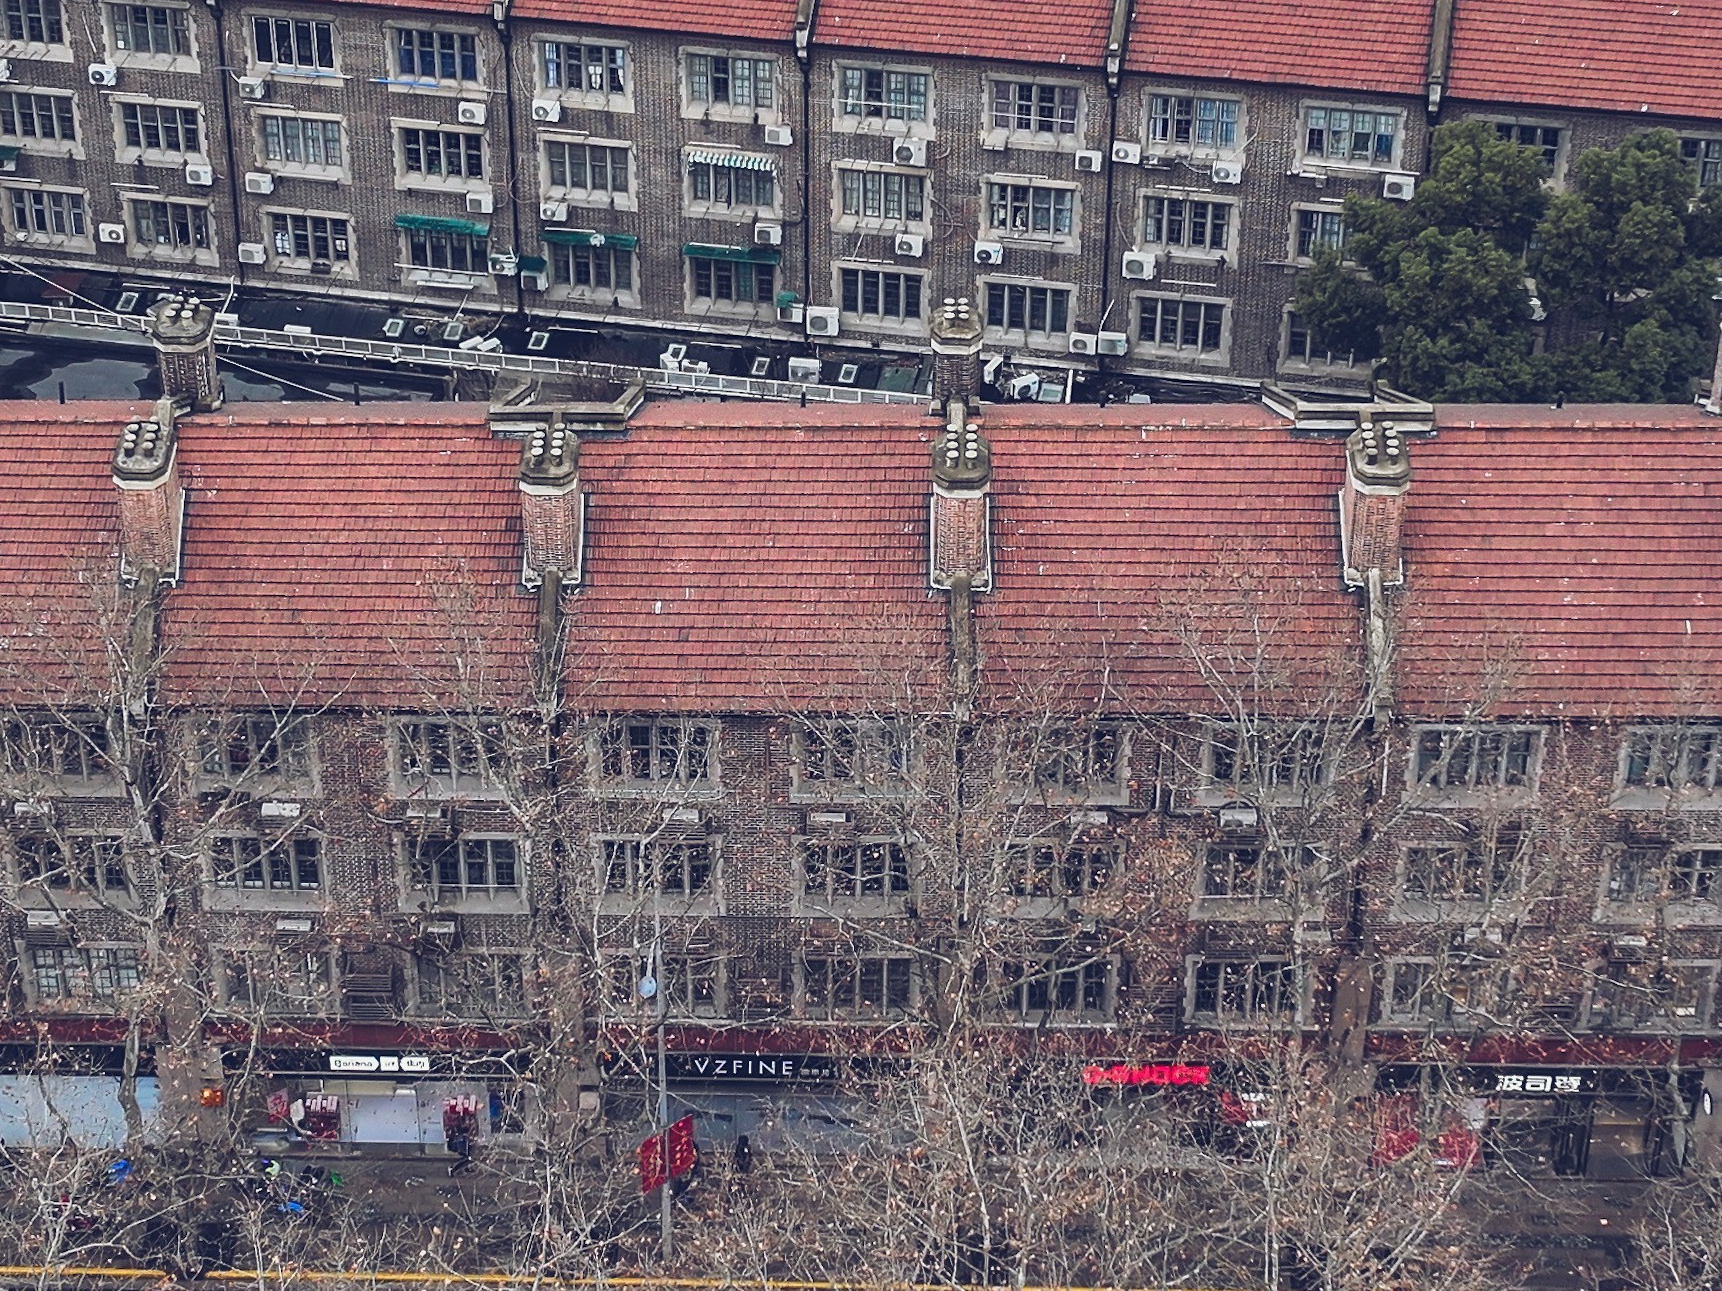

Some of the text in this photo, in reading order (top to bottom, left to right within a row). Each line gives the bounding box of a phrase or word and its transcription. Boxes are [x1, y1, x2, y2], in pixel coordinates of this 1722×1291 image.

[694, 1059, 794, 1076] VZFINE
[1495, 1075, 1582, 1092] 波司登
